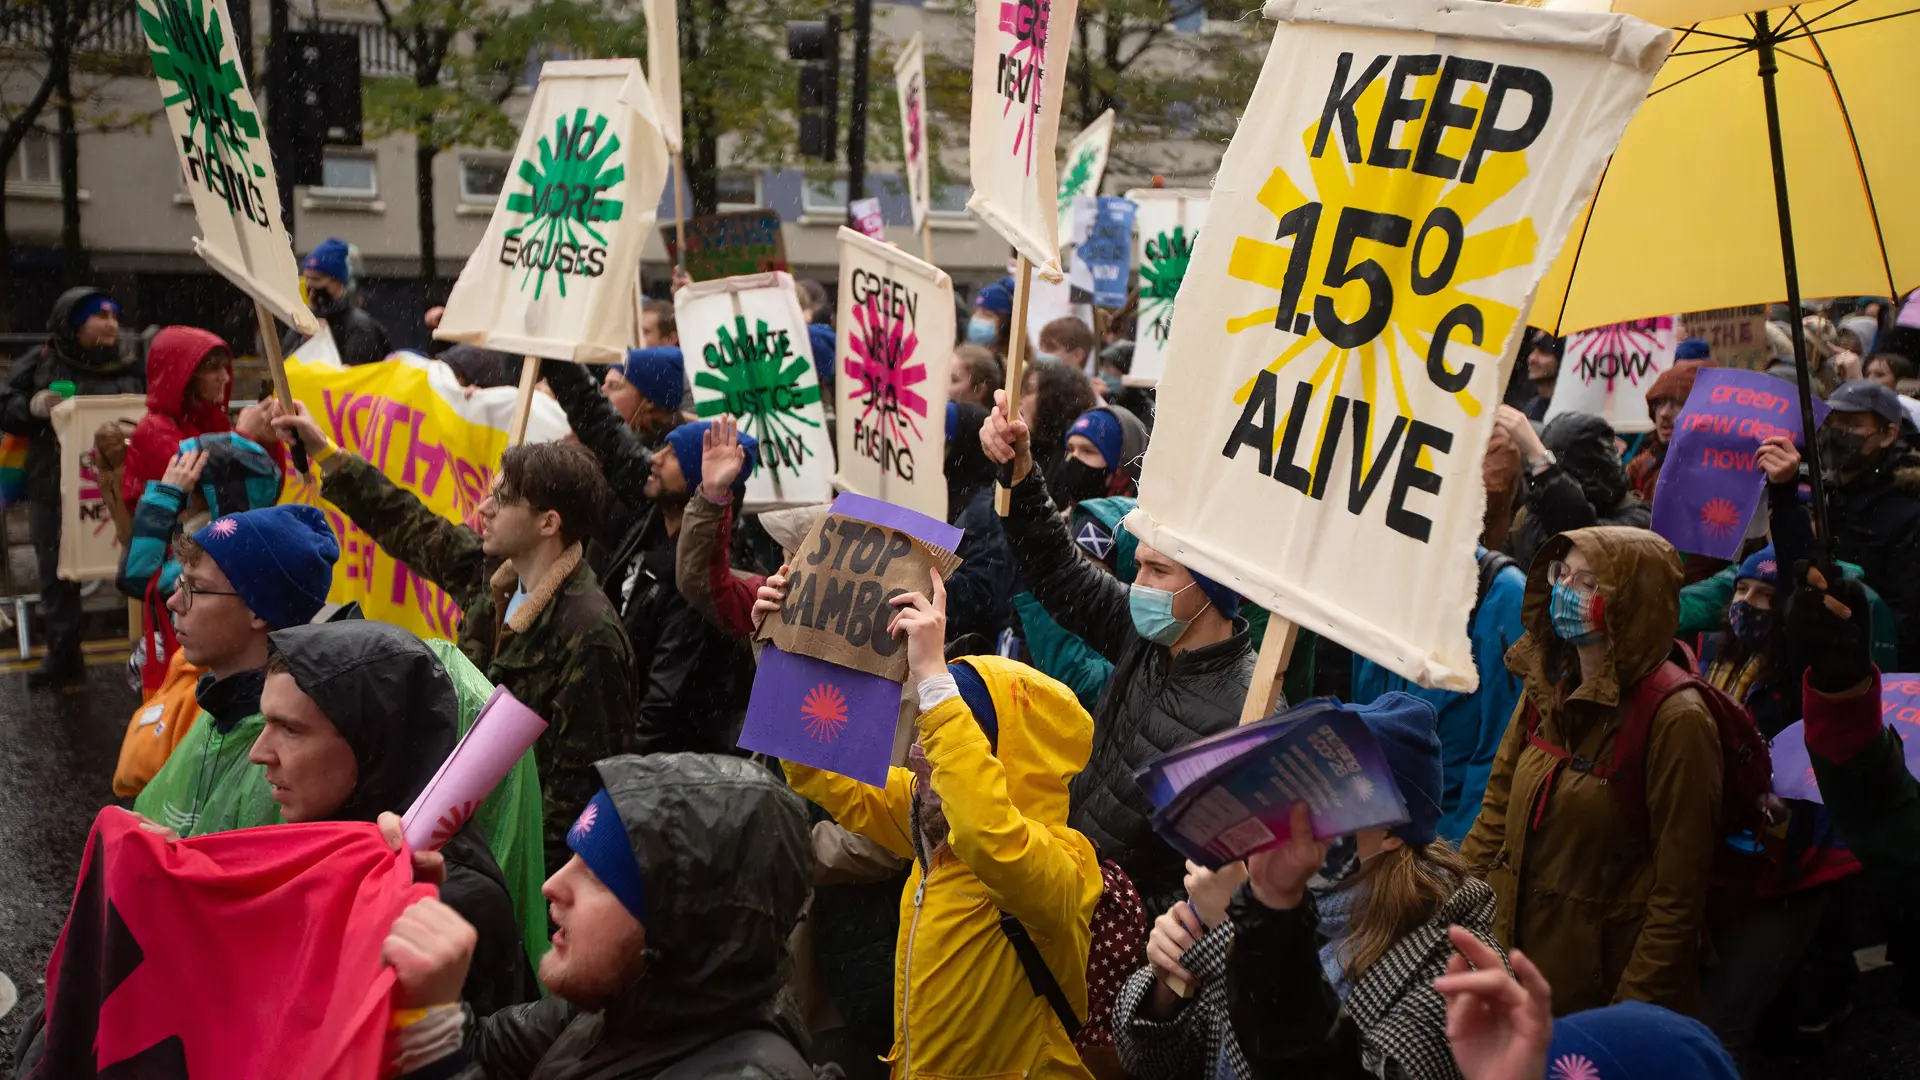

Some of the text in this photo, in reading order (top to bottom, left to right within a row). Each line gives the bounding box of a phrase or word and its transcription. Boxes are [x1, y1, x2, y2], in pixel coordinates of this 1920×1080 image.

[1310, 52, 1553, 184] KEEP
[554, 123, 598, 162] NO
[499, 236, 607, 278] EXCUSES
[703, 329, 794, 370] CLIMATE
[1581, 352, 1652, 381] NOW
[1709, 384, 1790, 415] green
[1681, 412, 1737, 436] new
[853, 417, 915, 485] RISING
[1222, 369, 1454, 544] ALIVE
[1702, 447, 1758, 474] now
[806, 516, 912, 577] STOP
[780, 571, 910, 658] CAMBO
